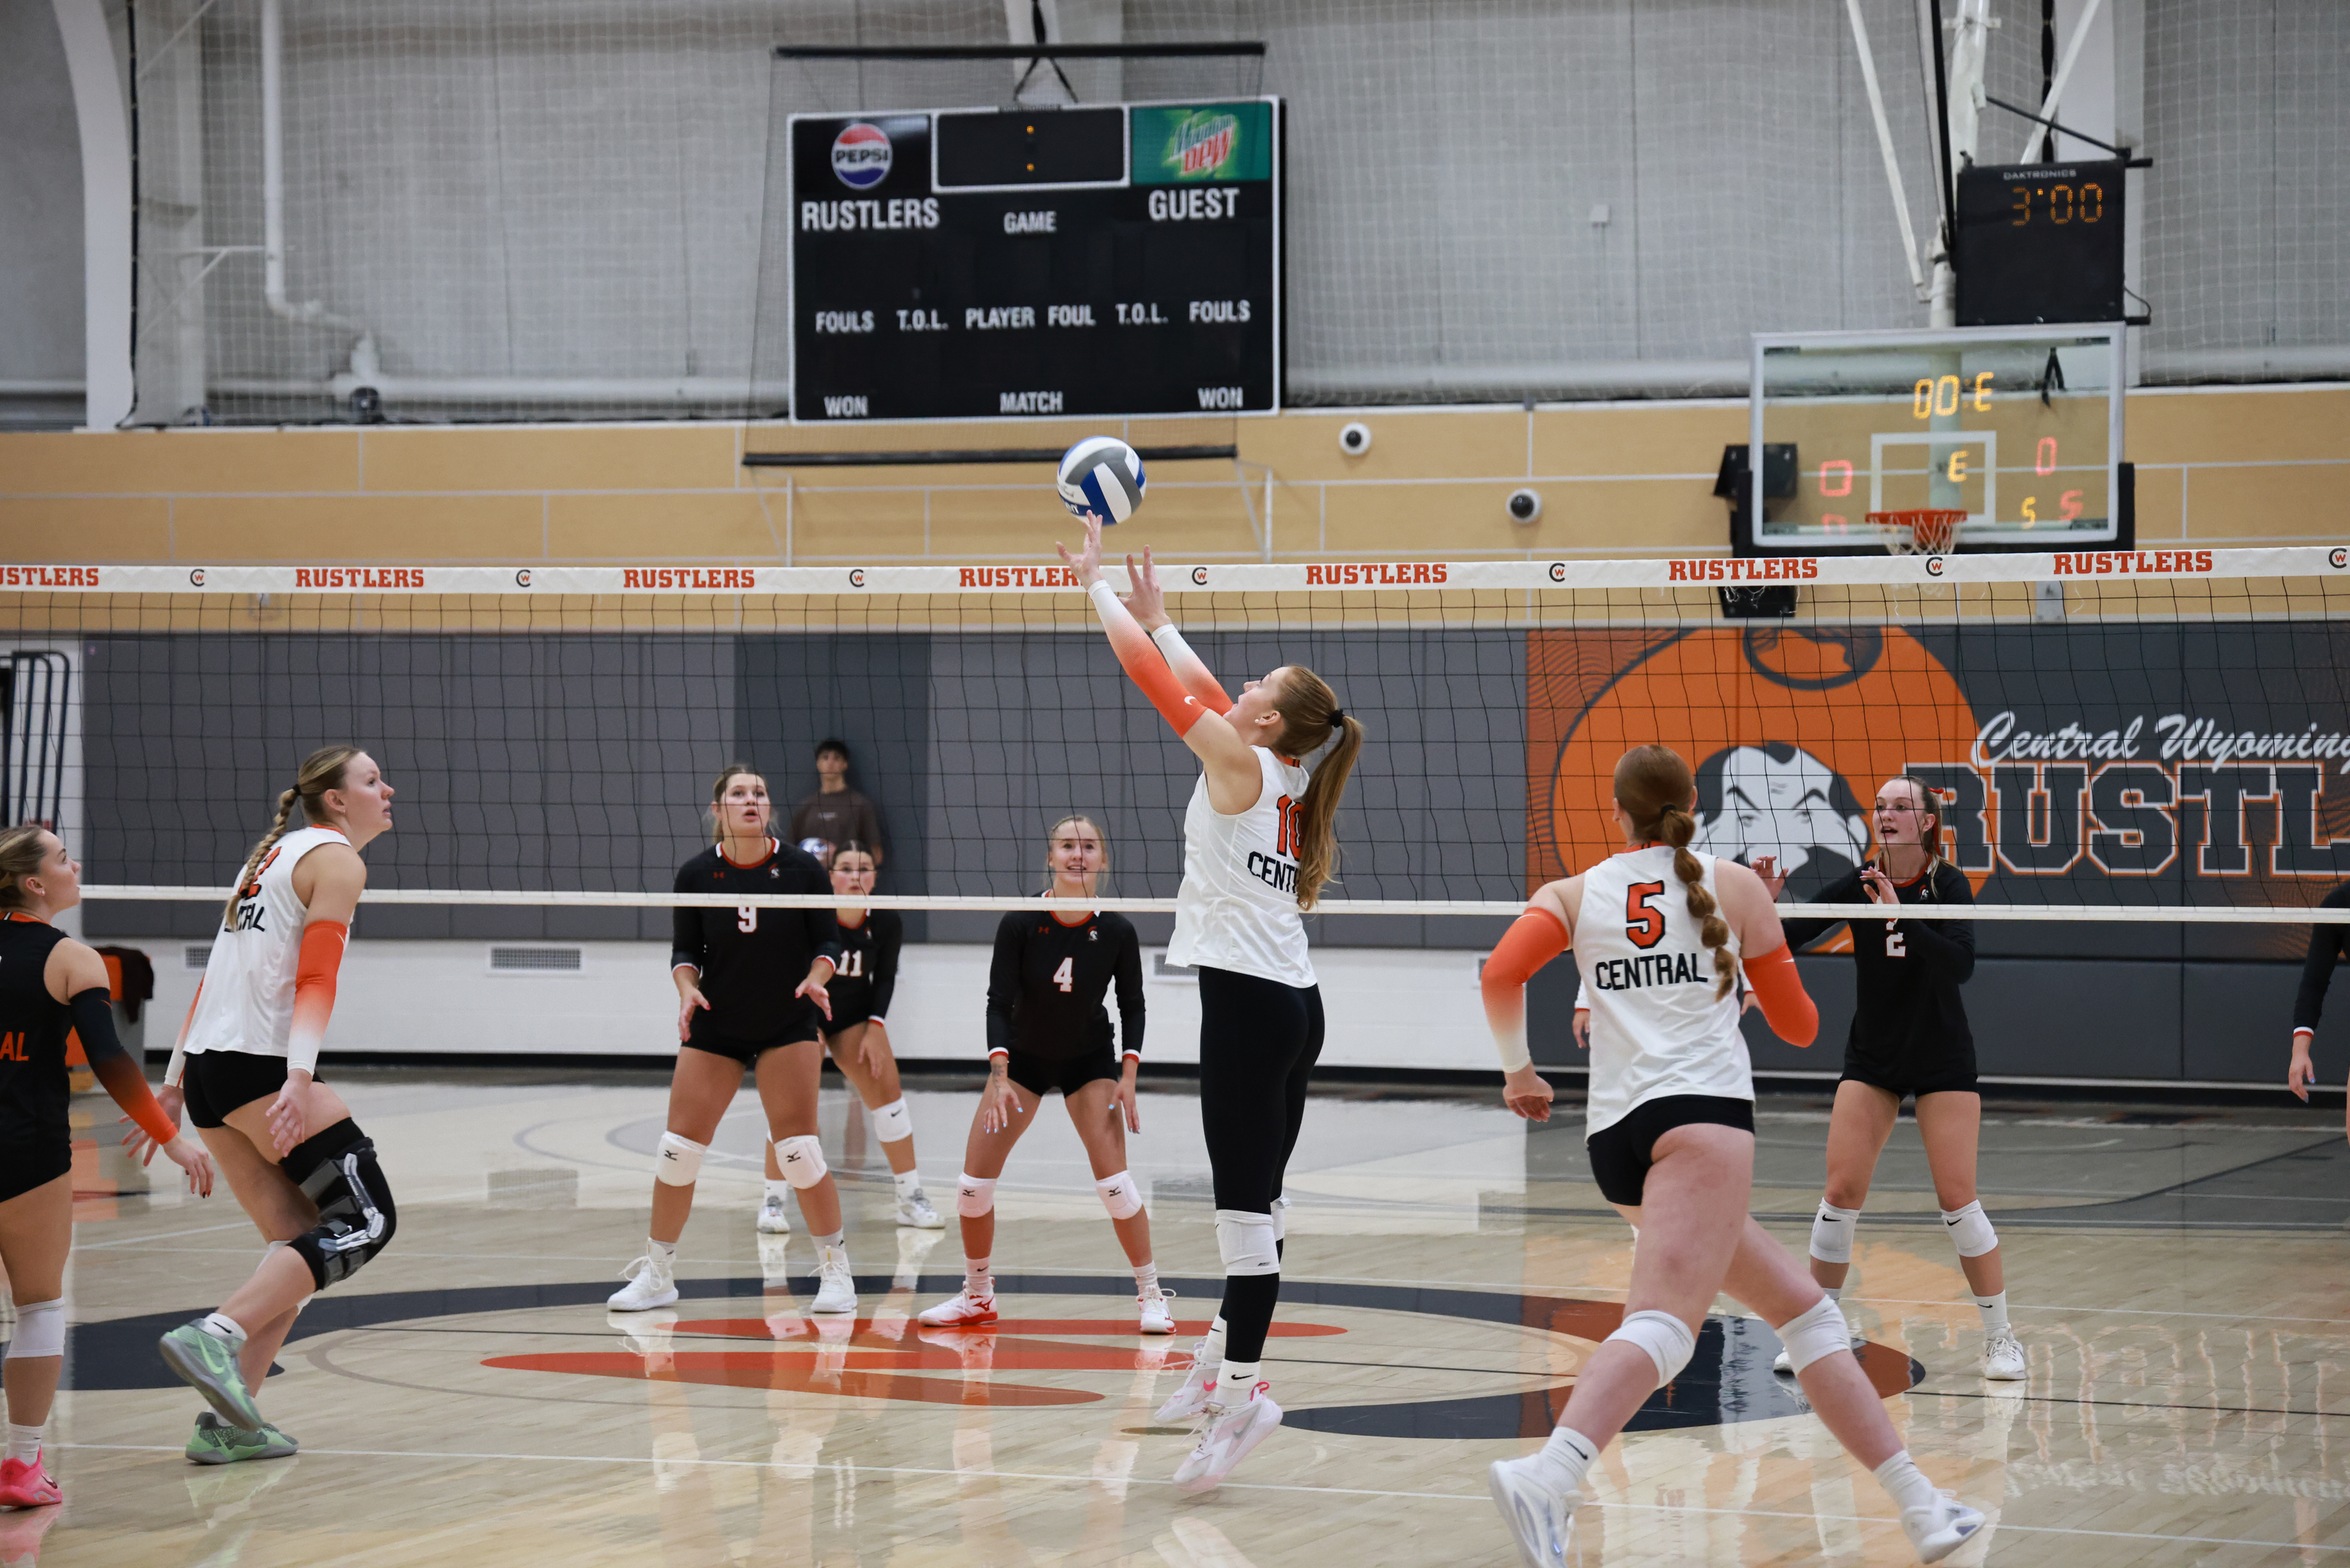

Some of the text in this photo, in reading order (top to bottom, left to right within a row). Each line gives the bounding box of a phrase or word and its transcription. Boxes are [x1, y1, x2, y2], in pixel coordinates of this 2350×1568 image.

[836, 148, 888, 163] PEPSI
[2003, 169, 2077, 180] DAKTRONICS
[802, 198, 940, 231] RUSTLERS
[1149, 188, 1240, 221] GUEST
[1004, 211, 1057, 234] GAME
[815, 311, 875, 333] FOULS
[897, 310, 948, 331] T.O.L.
[966, 305, 1096, 328] PLAYER FOUL
[1116, 304, 1168, 325] T.O.L.
[1190, 301, 1251, 322] FOULS
[825, 397, 869, 417] WON
[1000, 391, 1063, 413] MATCH
[1199, 387, 1243, 409] WON
[1306, 563, 1448, 585] RUSTLERS
[1669, 558, 1818, 581] RUSTLERS
[2053, 551, 2213, 575] RUSTLERS
[296, 568, 424, 588] RUSTLERS
[623, 569, 755, 589] RUSTLERS
[959, 567, 1081, 588] RUSTLER
[1970, 711, 2143, 767] Central
[1247, 851, 1301, 894] CENT
[738, 907, 757, 933] 9
[1626, 880, 1665, 949] 5
[1886, 920, 1906, 957] 2
[835, 950, 862, 977] 11
[1053, 957, 1074, 993] 4
[1595, 953, 1708, 991] CENTRAL
